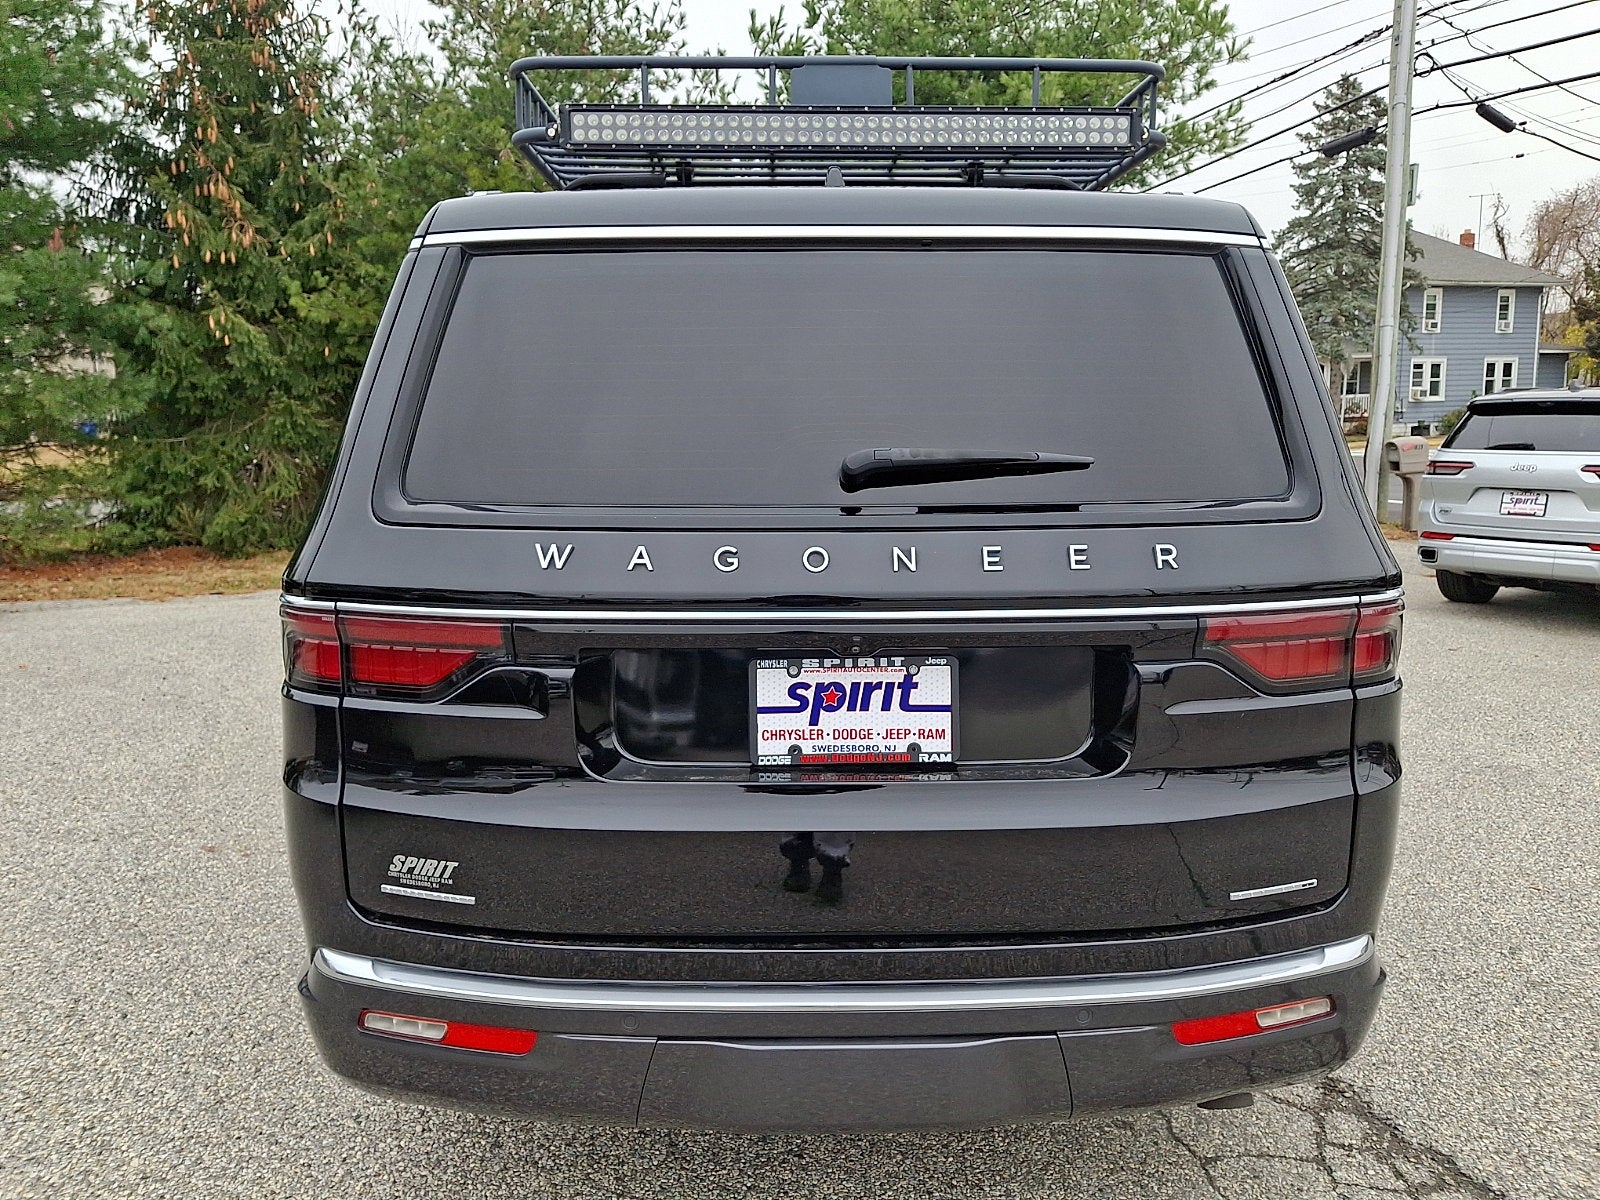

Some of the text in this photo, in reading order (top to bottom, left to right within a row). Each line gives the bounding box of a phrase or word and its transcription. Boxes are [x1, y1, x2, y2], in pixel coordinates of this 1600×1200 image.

[1510, 462, 1538, 473] Jeep
[1510, 496, 1539, 507] spirit
[534, 543, 1179, 573] WAGONEER
[757, 660, 788, 668] CHRYSLER
[801, 657, 905, 667] SPIRIT
[925, 657, 947, 666] Jeep
[787, 674, 919, 726] spirit
[761, 728, 946, 741] CHRYSLER DODGE JEEP RAM
[811, 745, 882, 753] SWEDESBORO,
[758, 755, 792, 765] DODGE
[918, 753, 952, 762] RAM
[389, 855, 459, 878] SPIRIT
